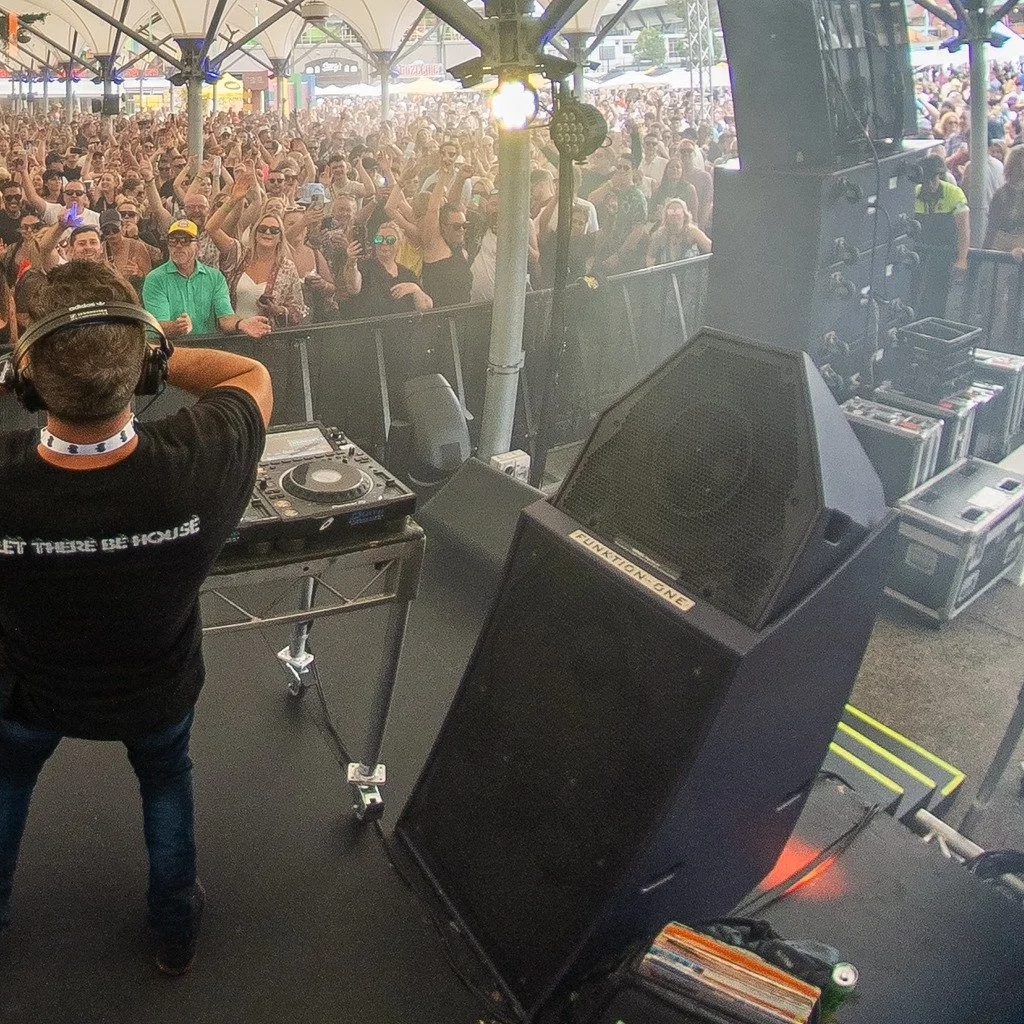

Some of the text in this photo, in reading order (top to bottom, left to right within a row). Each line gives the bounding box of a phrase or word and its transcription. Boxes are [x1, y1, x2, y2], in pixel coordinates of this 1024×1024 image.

[31, 537, 97, 554] THERE
[101, 535, 127, 552] BE
[132, 514, 200, 547] HOUSE
[575, 532, 688, 607] FUNKTION-ONE
